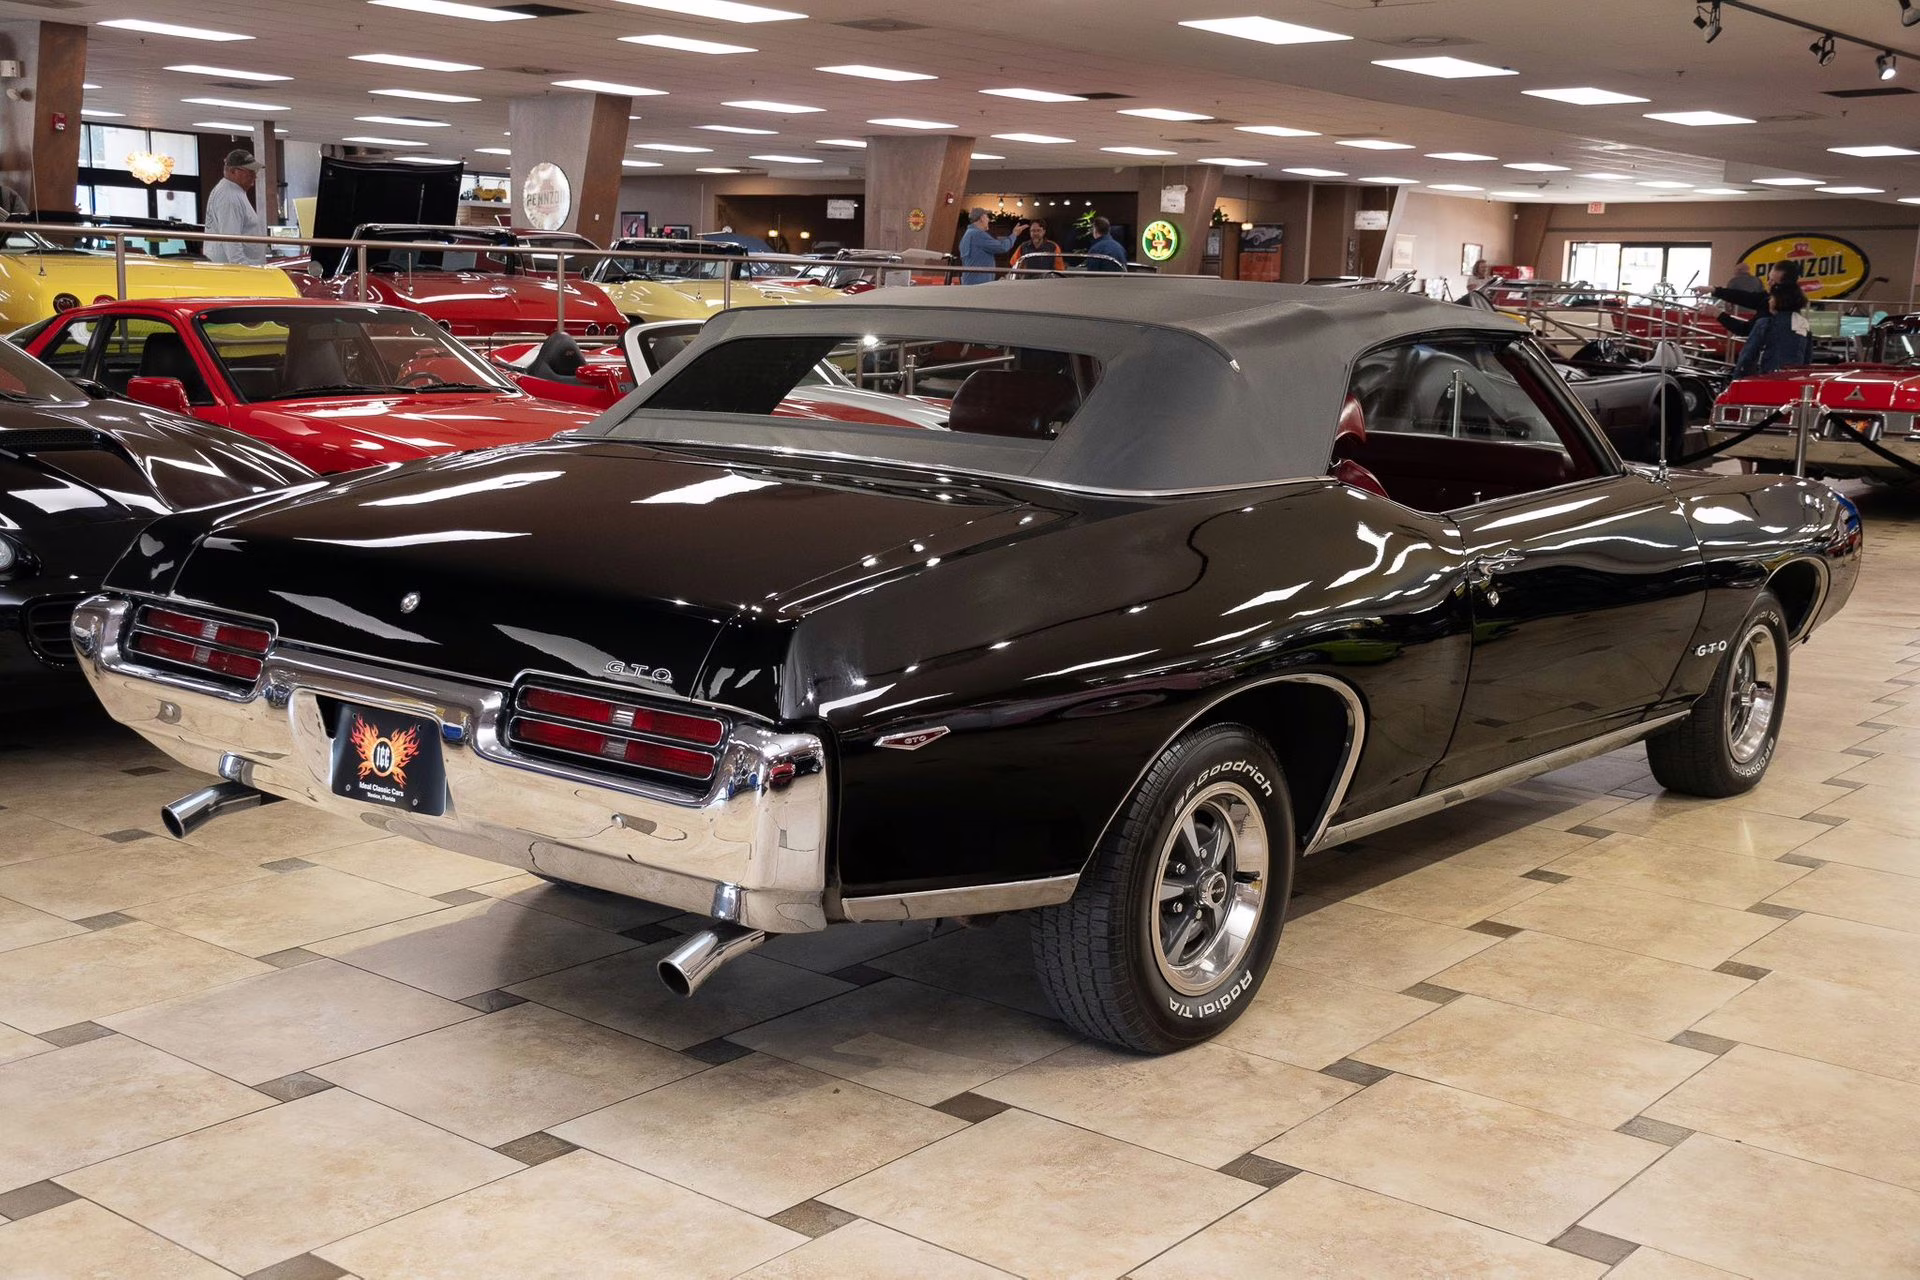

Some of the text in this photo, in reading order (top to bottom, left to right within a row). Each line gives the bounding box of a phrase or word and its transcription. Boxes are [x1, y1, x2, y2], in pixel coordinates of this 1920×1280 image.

[1697, 640, 1727, 656] GTO
[605, 660, 672, 682] GTO
[904, 735, 927, 745] GTO
[359, 781, 404, 797] Ideal Classic Cars
[1169, 969, 1253, 1018] Radial T/A
